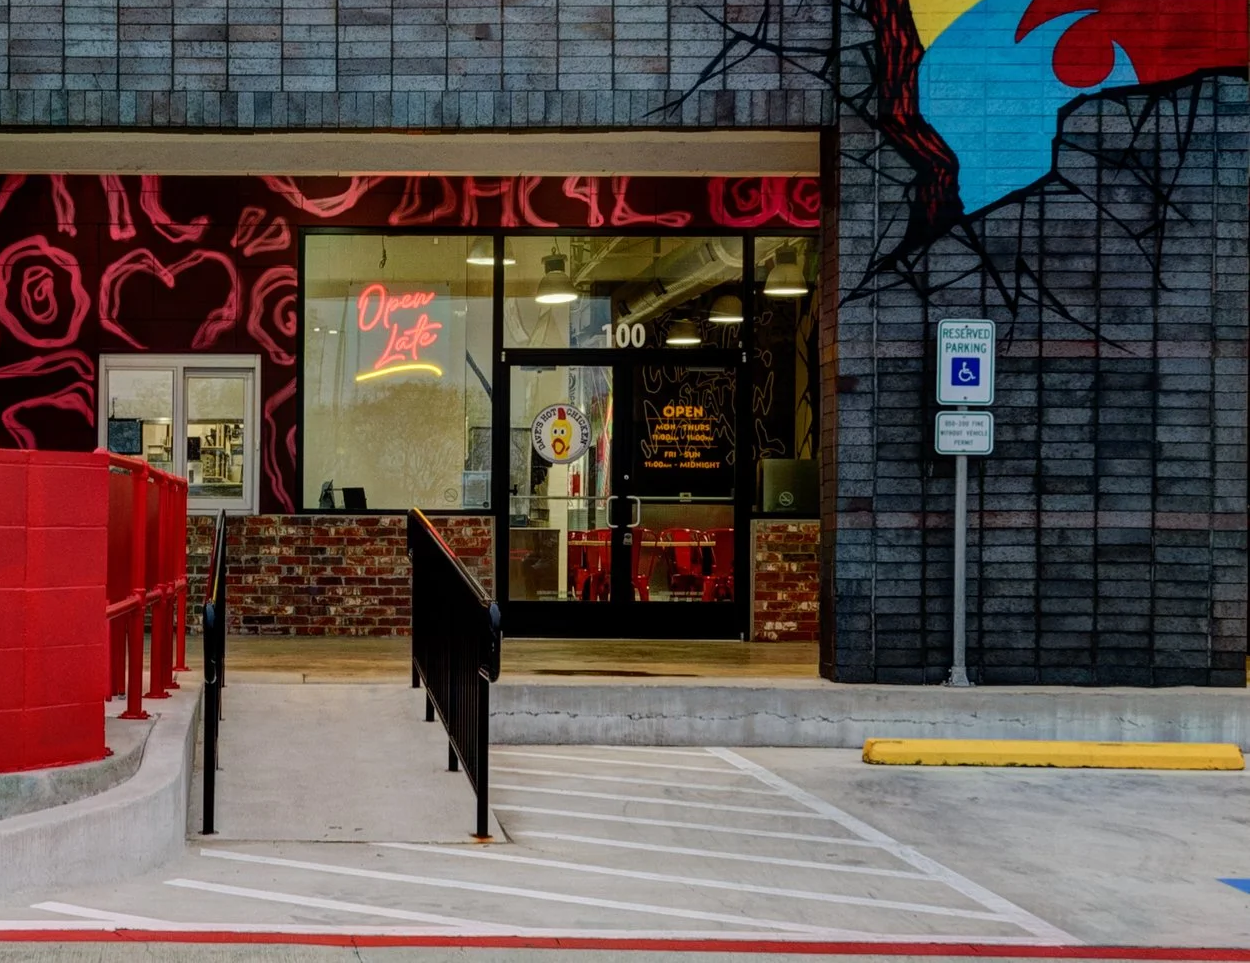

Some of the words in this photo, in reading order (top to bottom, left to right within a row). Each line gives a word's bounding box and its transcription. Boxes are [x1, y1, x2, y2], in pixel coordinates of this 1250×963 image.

[357, 284, 436, 331] Open
[374, 314, 442, 369] Late
[601, 322, 646, 349] 100
[942, 327, 991, 340] RESERVED
[945, 342, 987, 354] PARKING
[662, 405, 704, 418] OPEN
[534, 421, 546, 451] DAVE'S
[540, 408, 557, 423] HOT
[566, 408, 589, 446] CHICKEN
[679, 461, 721, 469] MIDNIGHT
